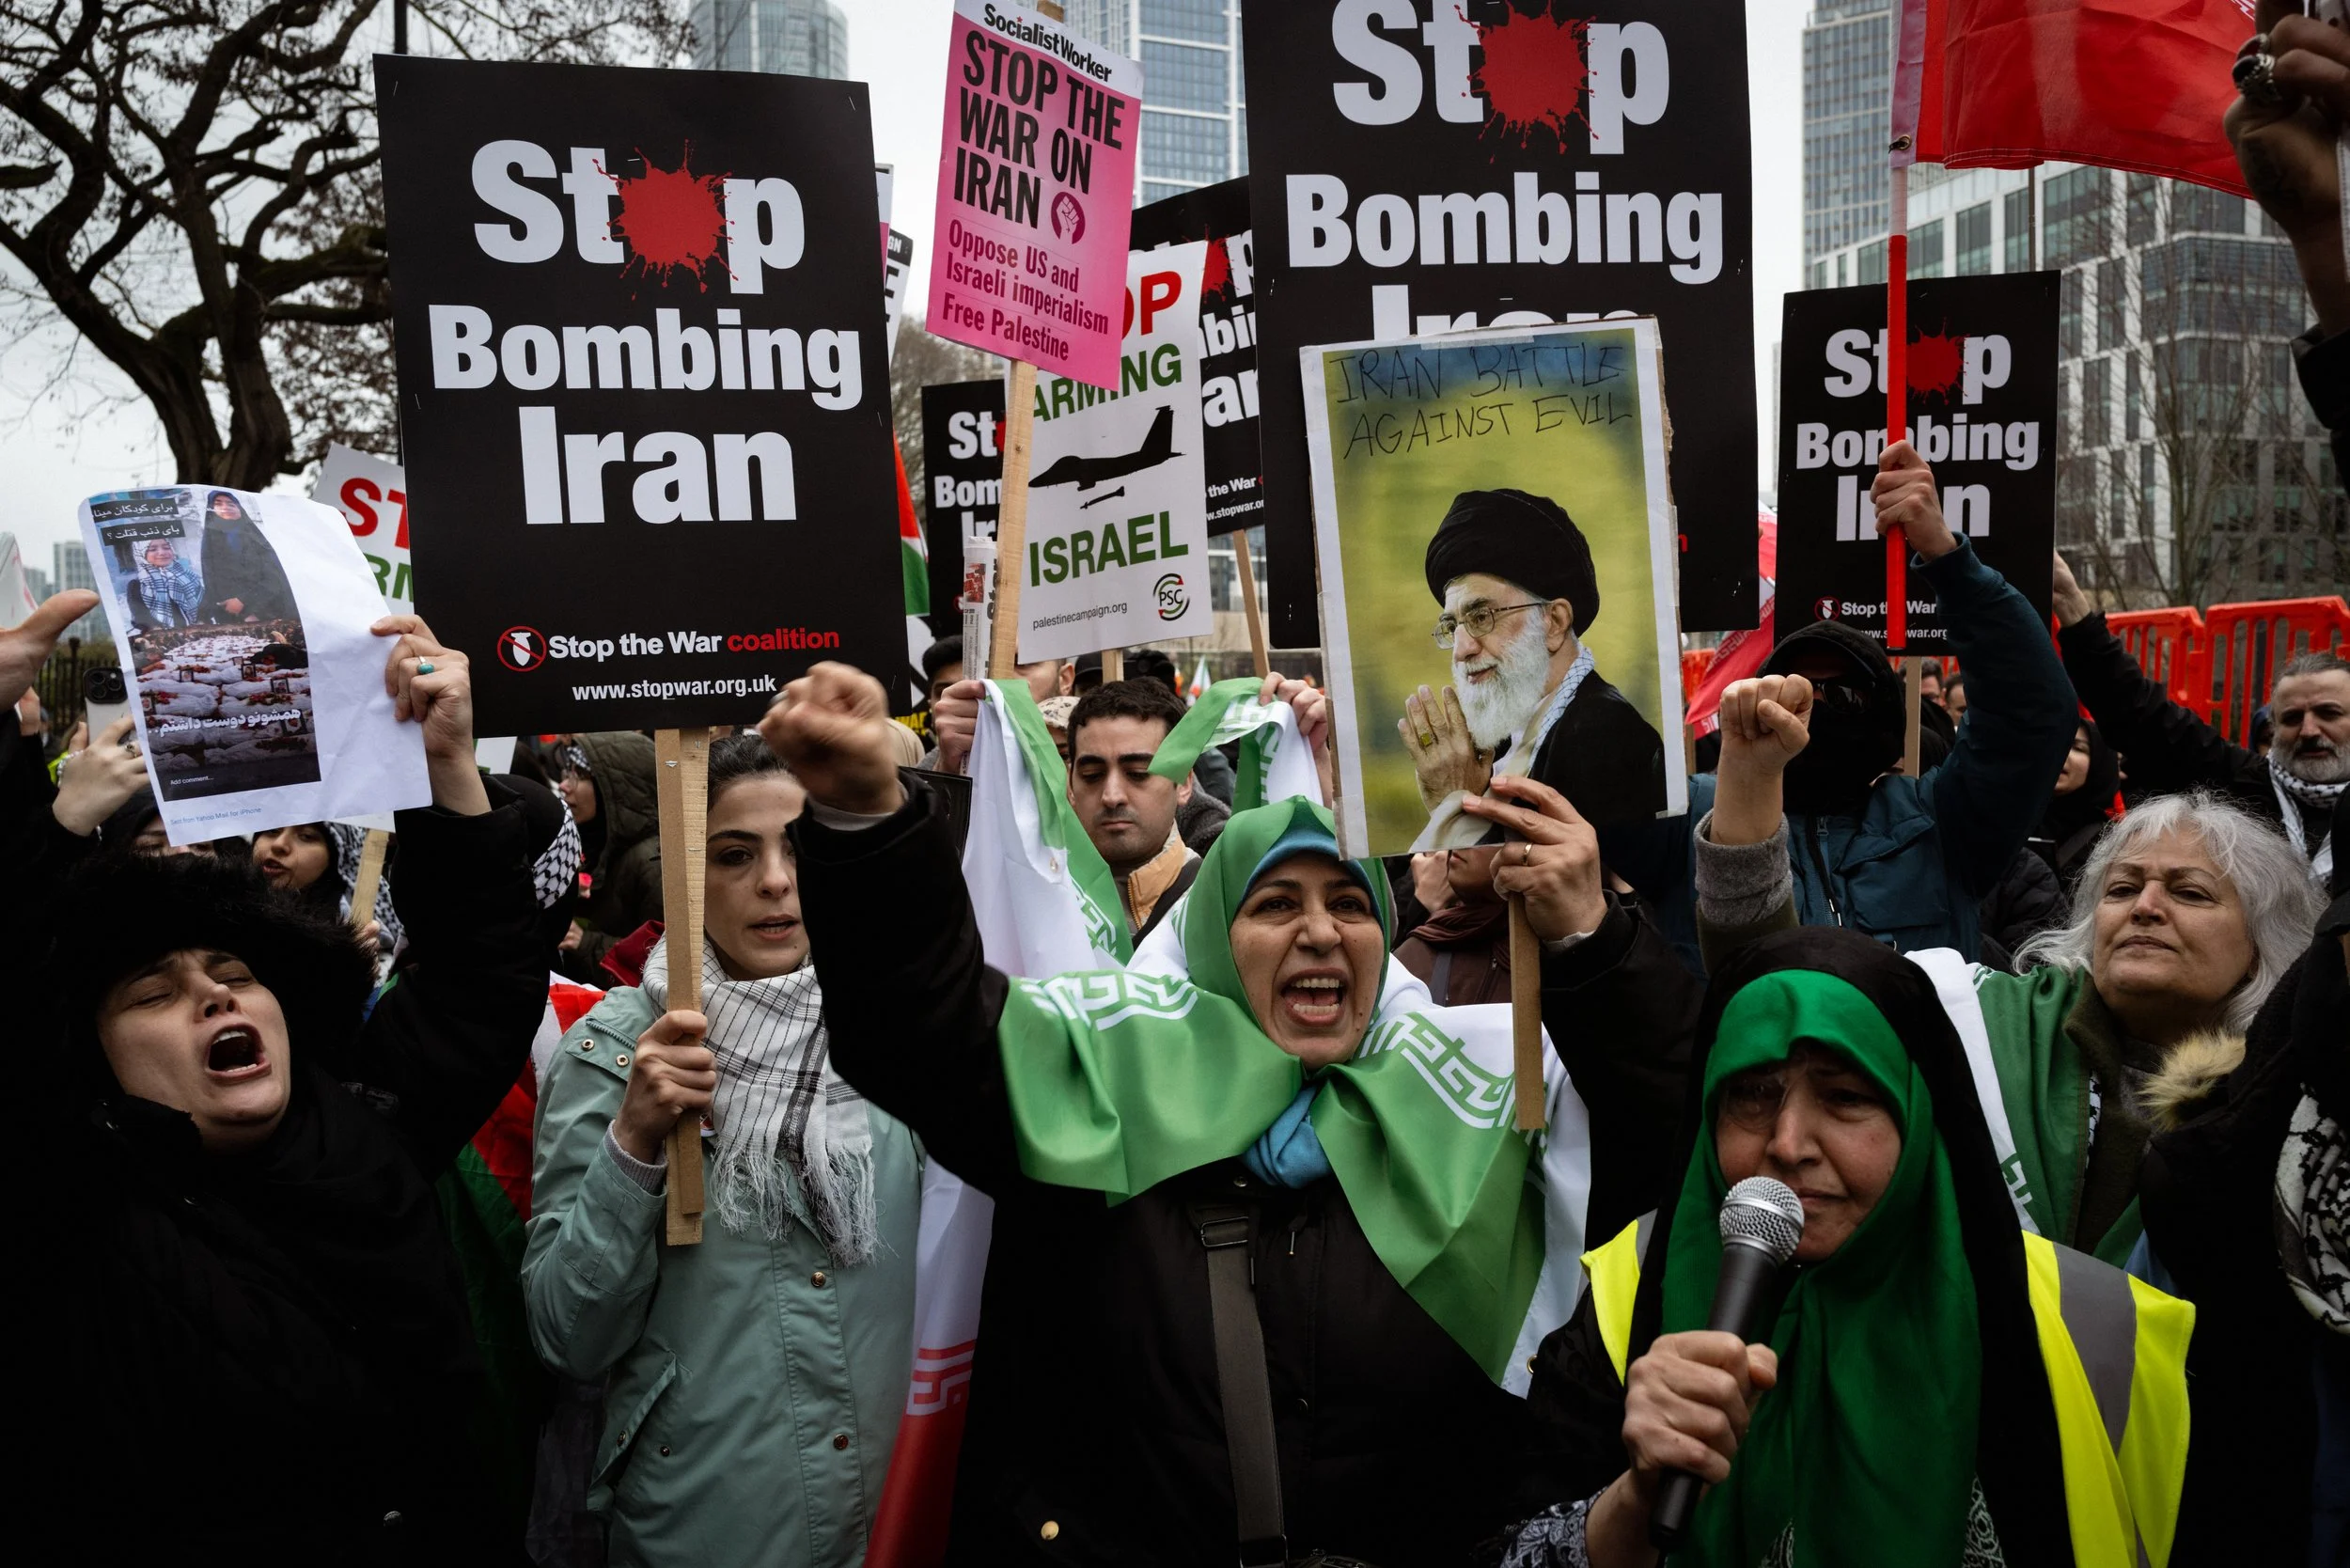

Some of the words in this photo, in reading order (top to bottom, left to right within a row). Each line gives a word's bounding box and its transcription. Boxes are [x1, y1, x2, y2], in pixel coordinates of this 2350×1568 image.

[964, 30, 1058, 112] STOP
[1067, 74, 1125, 150] THE
[1332, 0, 1669, 155] Stp
[961, 86, 1039, 169] WAR
[1051, 128, 1092, 195] ON
[472, 139, 805, 294] Stp
[954, 147, 1041, 229] IRAN
[949, 219, 1018, 268] Oppose
[1026, 245, 1048, 278] US
[1051, 265, 1079, 293] and
[1286, 172, 1723, 284] Bombing
[943, 292, 984, 331] Free
[992, 308, 1069, 361] Palestine
[947, 252, 1006, 298] Israeli
[1012, 274, 1109, 335] imperialism
[429, 305, 862, 411] Bombing
[1033, 343, 1183, 421] ARMNG
[1329, 345, 1441, 402] IRAN
[1469, 342, 1627, 397] BATTLE
[1825, 329, 2012, 405] Sp
[948, 411, 998, 460] St
[1343, 403, 1513, 459] AGAINST
[1532, 392, 1633, 433] EVIL
[519, 406, 797, 525] Iran
[1208, 485, 1229, 497] the
[1230, 478, 1257, 492] War
[114, 503, 149, 516] کودکان
[151, 502, 173, 514] برای
[339, 478, 410, 550] ST
[1206, 499, 1264, 521] w.stopwar.o
[1836, 475, 1990, 541] In
[1029, 510, 1189, 587] ISRAEL
[1032, 602, 1127, 631] palestinecampaign.org
[1159, 589, 1183, 606] PSC
[1841, 602, 1877, 618] Stop
[1906, 601, 1936, 614] War
[549, 635, 614, 662] Stop
[619, 634, 663, 656] the
[667, 631, 722, 653] War
[727, 628, 839, 651] coalition
[572, 674, 776, 699] www.stopwar.org.uk
[241, 808, 261, 816] iPhone
